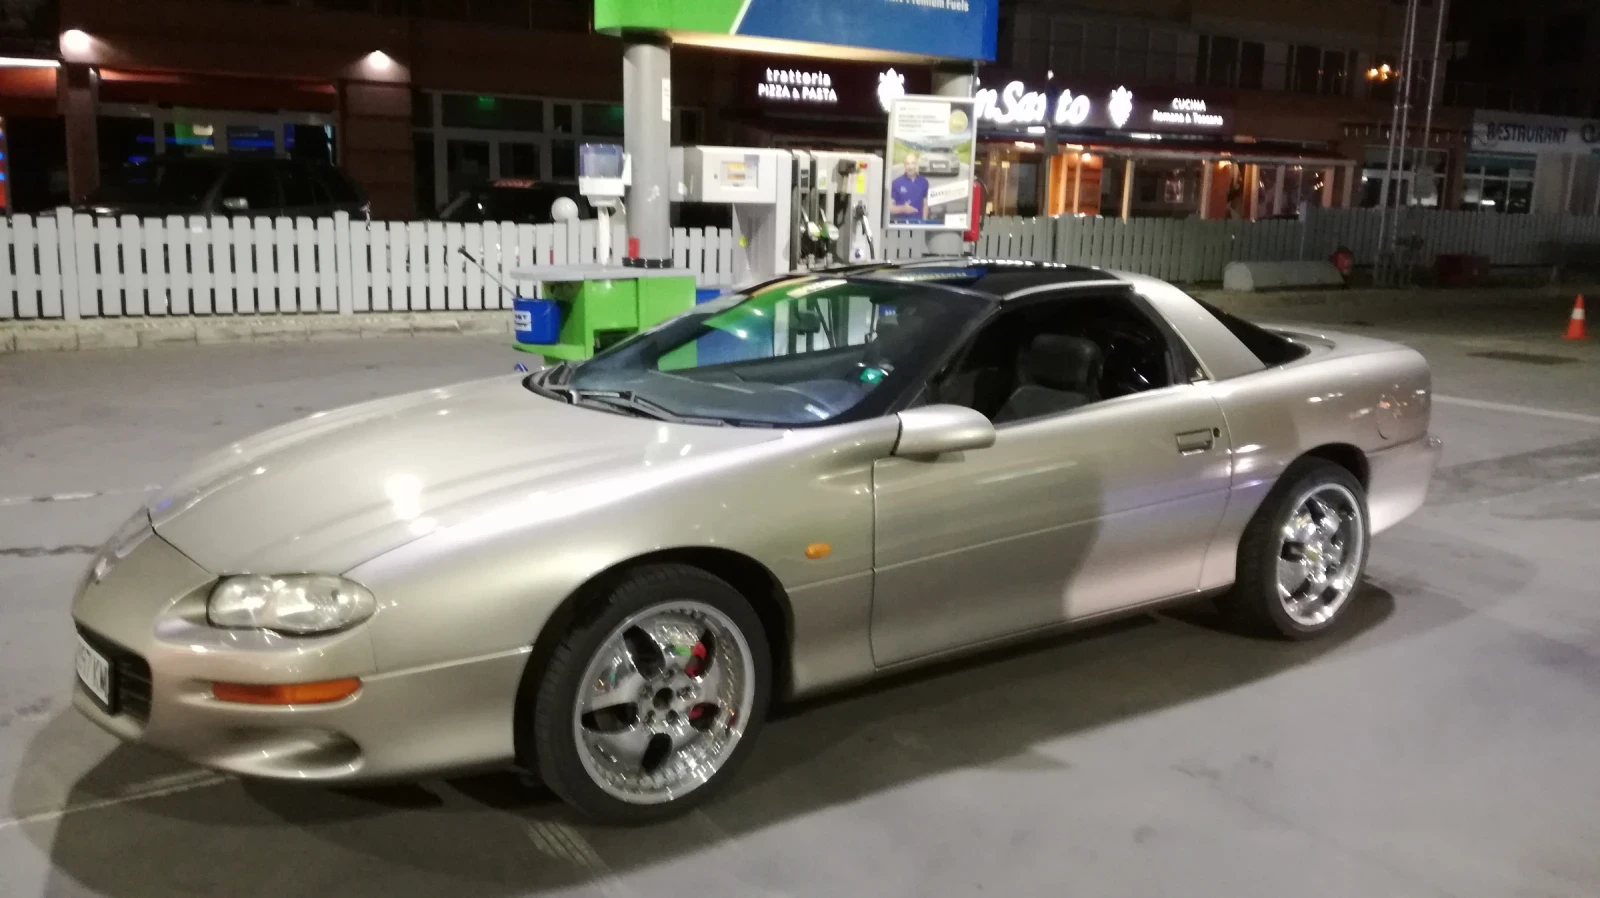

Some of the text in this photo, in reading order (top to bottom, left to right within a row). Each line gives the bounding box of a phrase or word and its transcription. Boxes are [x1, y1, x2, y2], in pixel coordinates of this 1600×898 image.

[945, 0, 969, 12] Fuels
[766, 67, 832, 86] trattoria
[758, 83, 791, 98] PIZZA
[802, 86, 838, 101] PASTA
[1172, 97, 1206, 111] CUCINA
